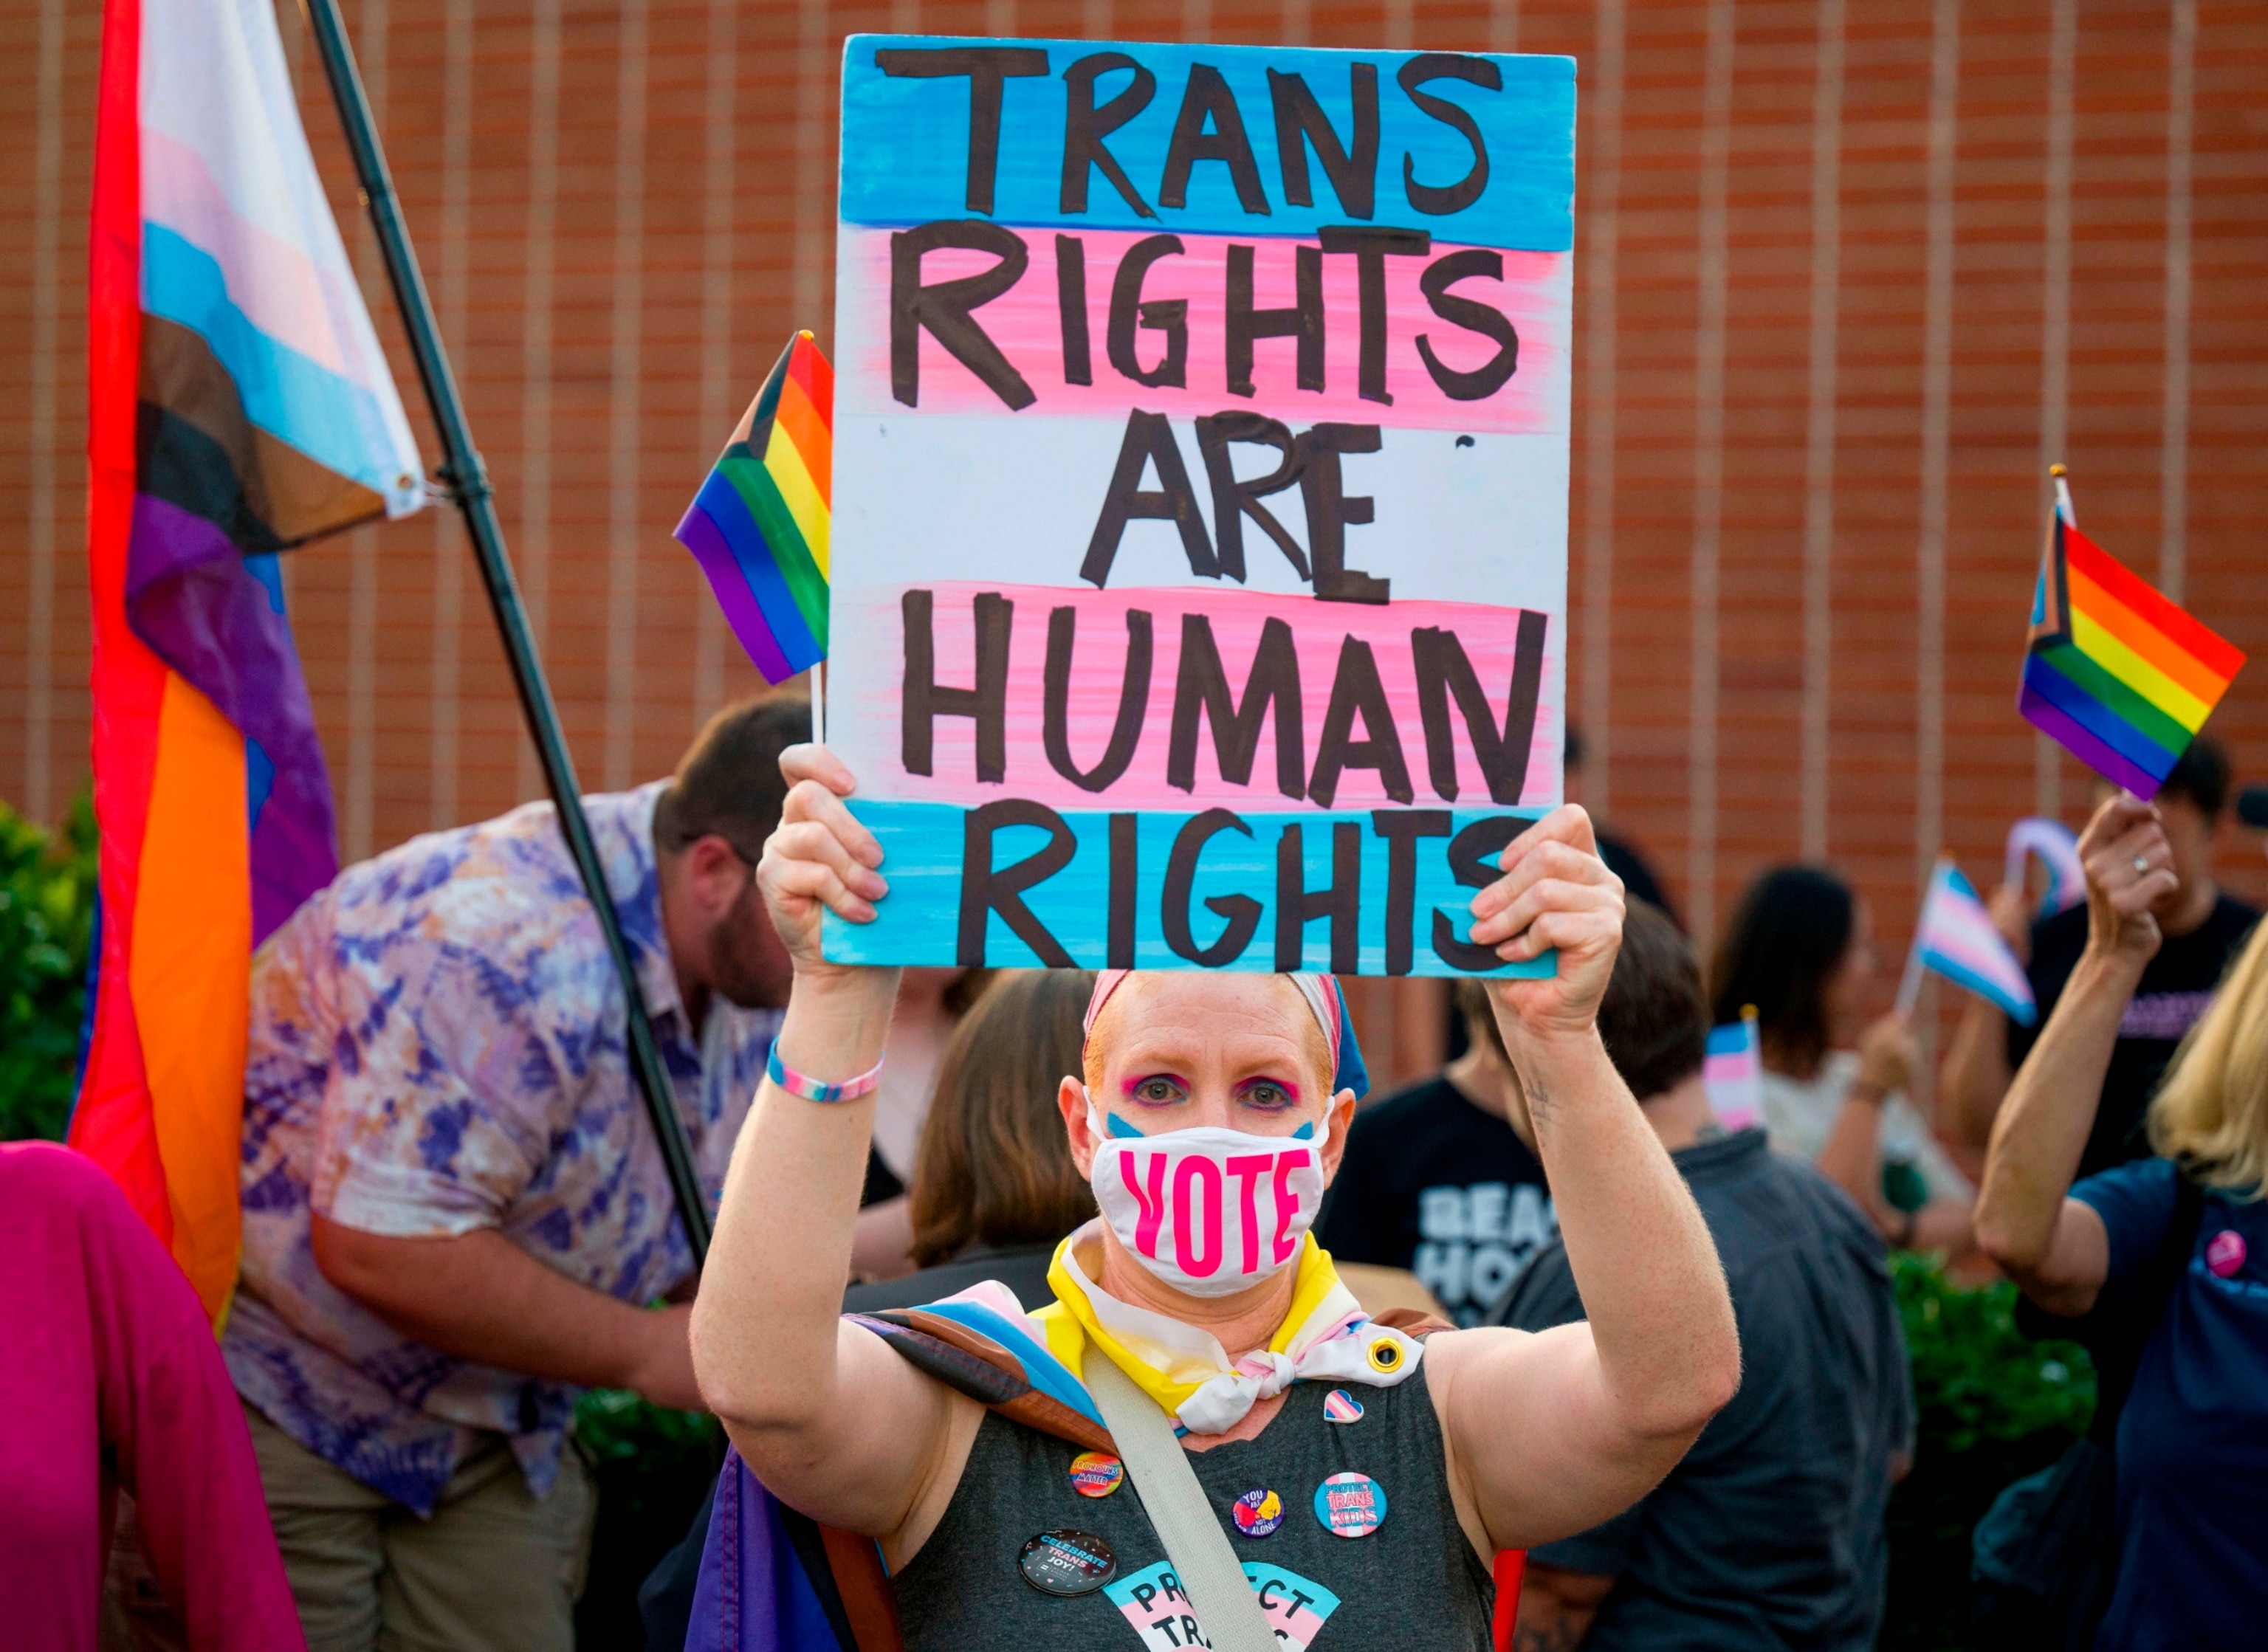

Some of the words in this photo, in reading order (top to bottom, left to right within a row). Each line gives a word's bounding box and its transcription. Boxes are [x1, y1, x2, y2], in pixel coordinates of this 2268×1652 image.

[875, 49, 1502, 221] TRANS
[891, 219, 1519, 411] RIGHTS
[1080, 409, 1390, 605] ARE
[901, 590, 1547, 808] HUMAN
[957, 799, 1542, 976] RIGHTS
[1118, 1149, 1311, 1278] VOTE
[1419, 1182, 1557, 1247] BEA
[1414, 1243, 1538, 1309] HO
[1072, 1461, 1118, 1476] PRONOUNS
[1077, 1473, 1108, 1486] MATTER
[1243, 1490, 1263, 1504] YOU
[1324, 1481, 1373, 1494] PROTECT
[1325, 1492, 1375, 1508] TRANS
[1250, 1499, 1260, 1509] ARE
[1328, 1506, 1379, 1529] KIDS
[1251, 1521, 1276, 1535] ALONE
[1040, 1535, 1108, 1568] CELEBRATE
[1047, 1556, 1076, 1572] JOY!
[1048, 1546, 1089, 1568] TRANS
[1130, 1572, 1315, 1620] PRCT
